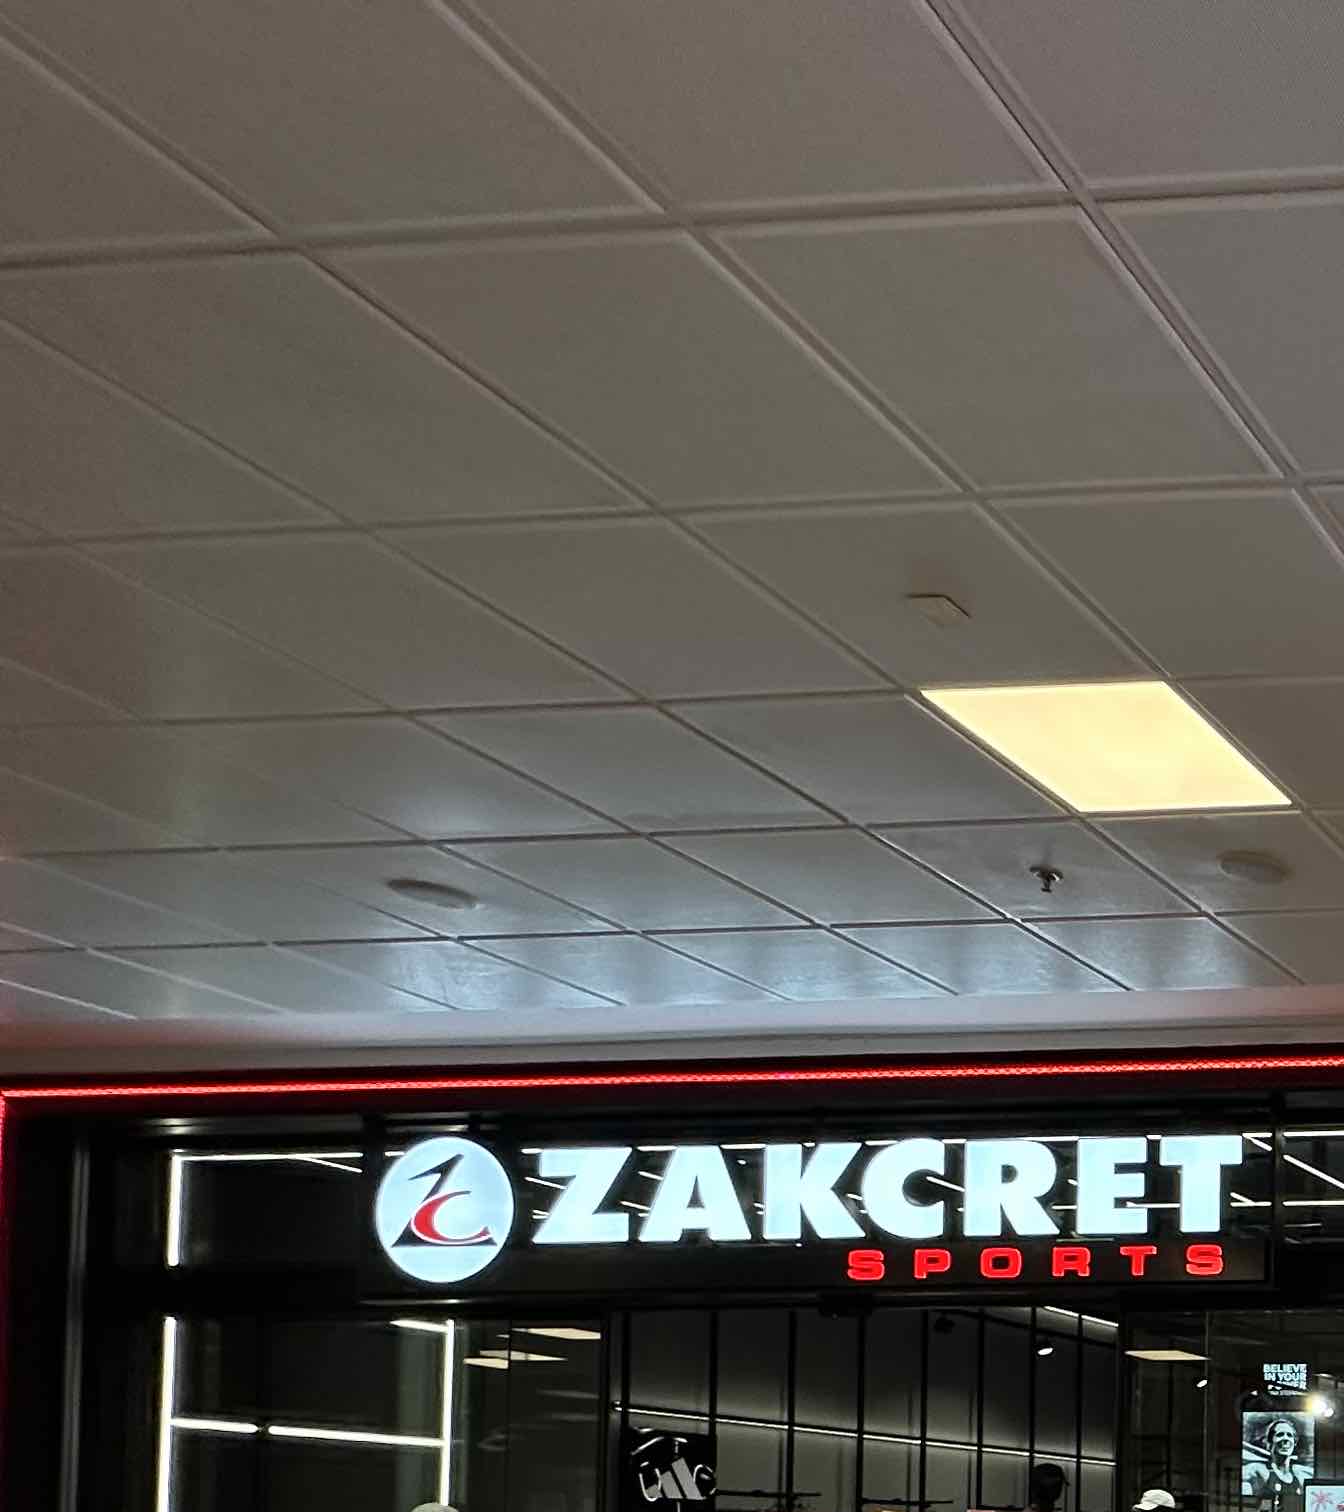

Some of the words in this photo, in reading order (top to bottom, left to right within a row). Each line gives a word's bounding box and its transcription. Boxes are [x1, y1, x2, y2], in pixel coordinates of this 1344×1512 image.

[531, 1135, 1243, 1244] ZAKCRET
[846, 1244, 1225, 1282] SPORTS
[1263, 1363, 1307, 1373] BELIEVE
